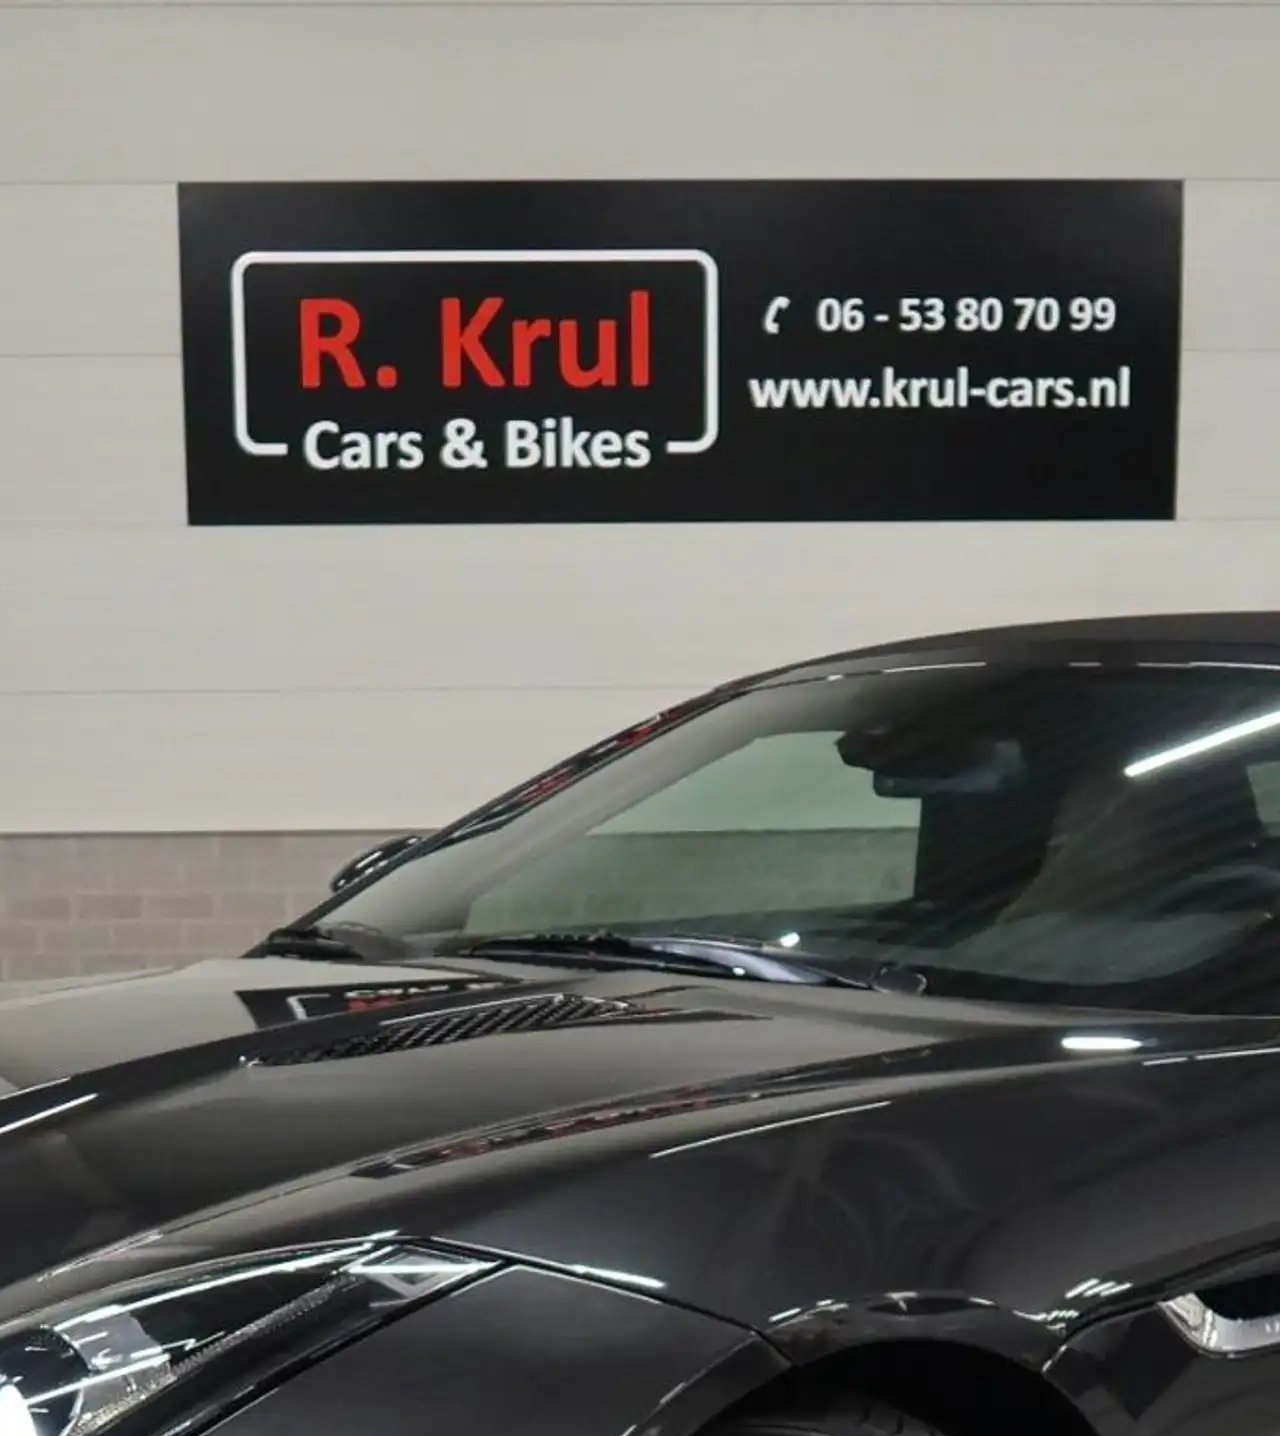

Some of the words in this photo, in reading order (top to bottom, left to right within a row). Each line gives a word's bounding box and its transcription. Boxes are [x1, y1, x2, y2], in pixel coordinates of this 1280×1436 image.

[816, 297, 865, 332] 06
[899, 297, 946, 332] 53
[955, 297, 1004, 332] 80
[1013, 297, 1060, 332] 70
[1069, 296, 1116, 332] 99
[298, 297, 400, 392] R.
[440, 288, 653, 391] Krul
[748, 365, 1131, 409] www.krul-cars.nl
[303, 420, 424, 470] Cars
[440, 417, 488, 469] &
[505, 416, 651, 469] Bikes
